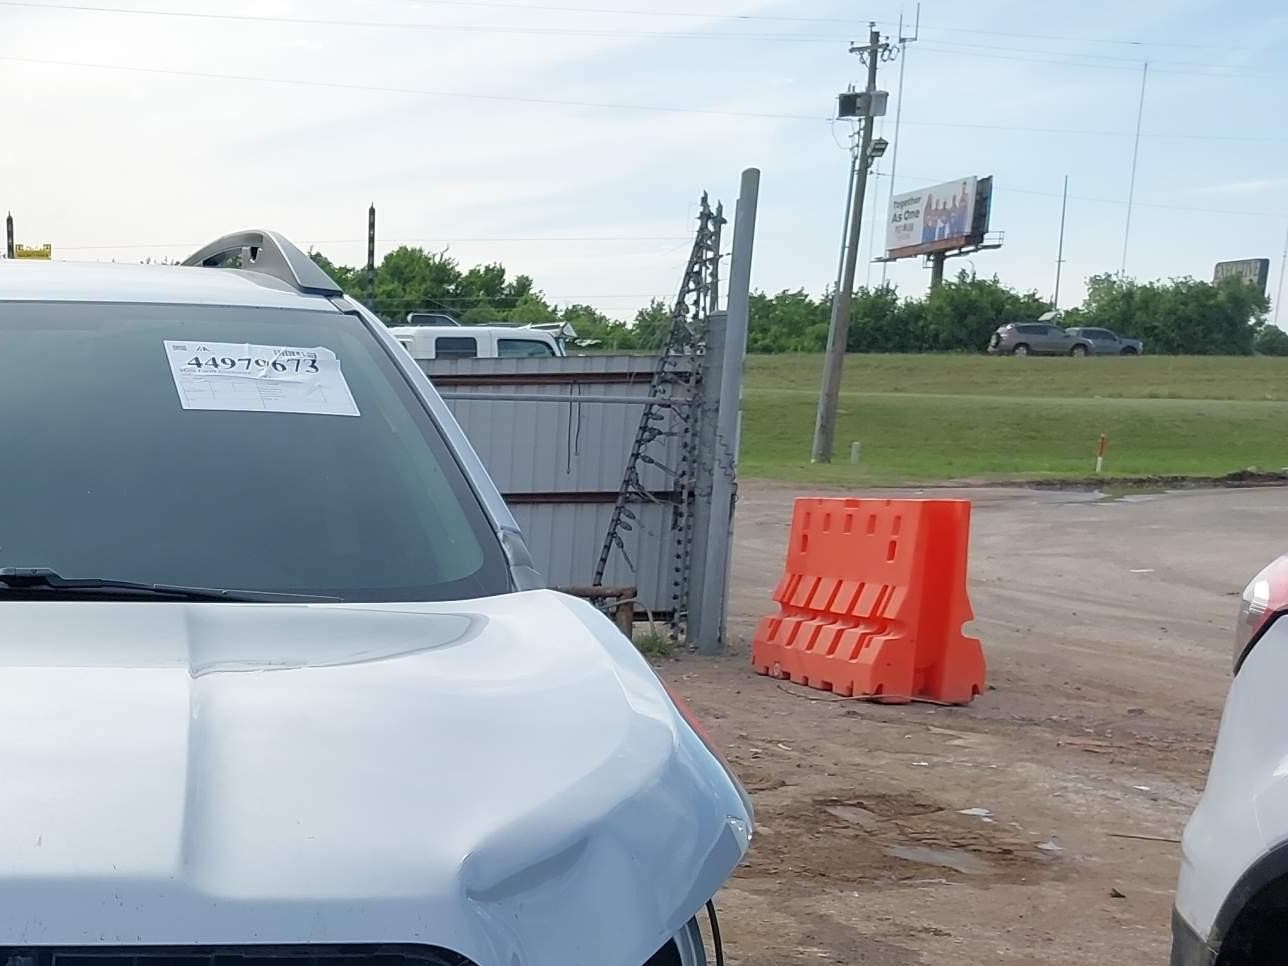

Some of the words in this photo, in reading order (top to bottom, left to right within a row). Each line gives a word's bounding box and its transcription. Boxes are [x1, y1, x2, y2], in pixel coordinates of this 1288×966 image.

[892, 213, 902, 223] As
[903, 209, 920, 220] One
[187, 356, 320, 374] 44979673
